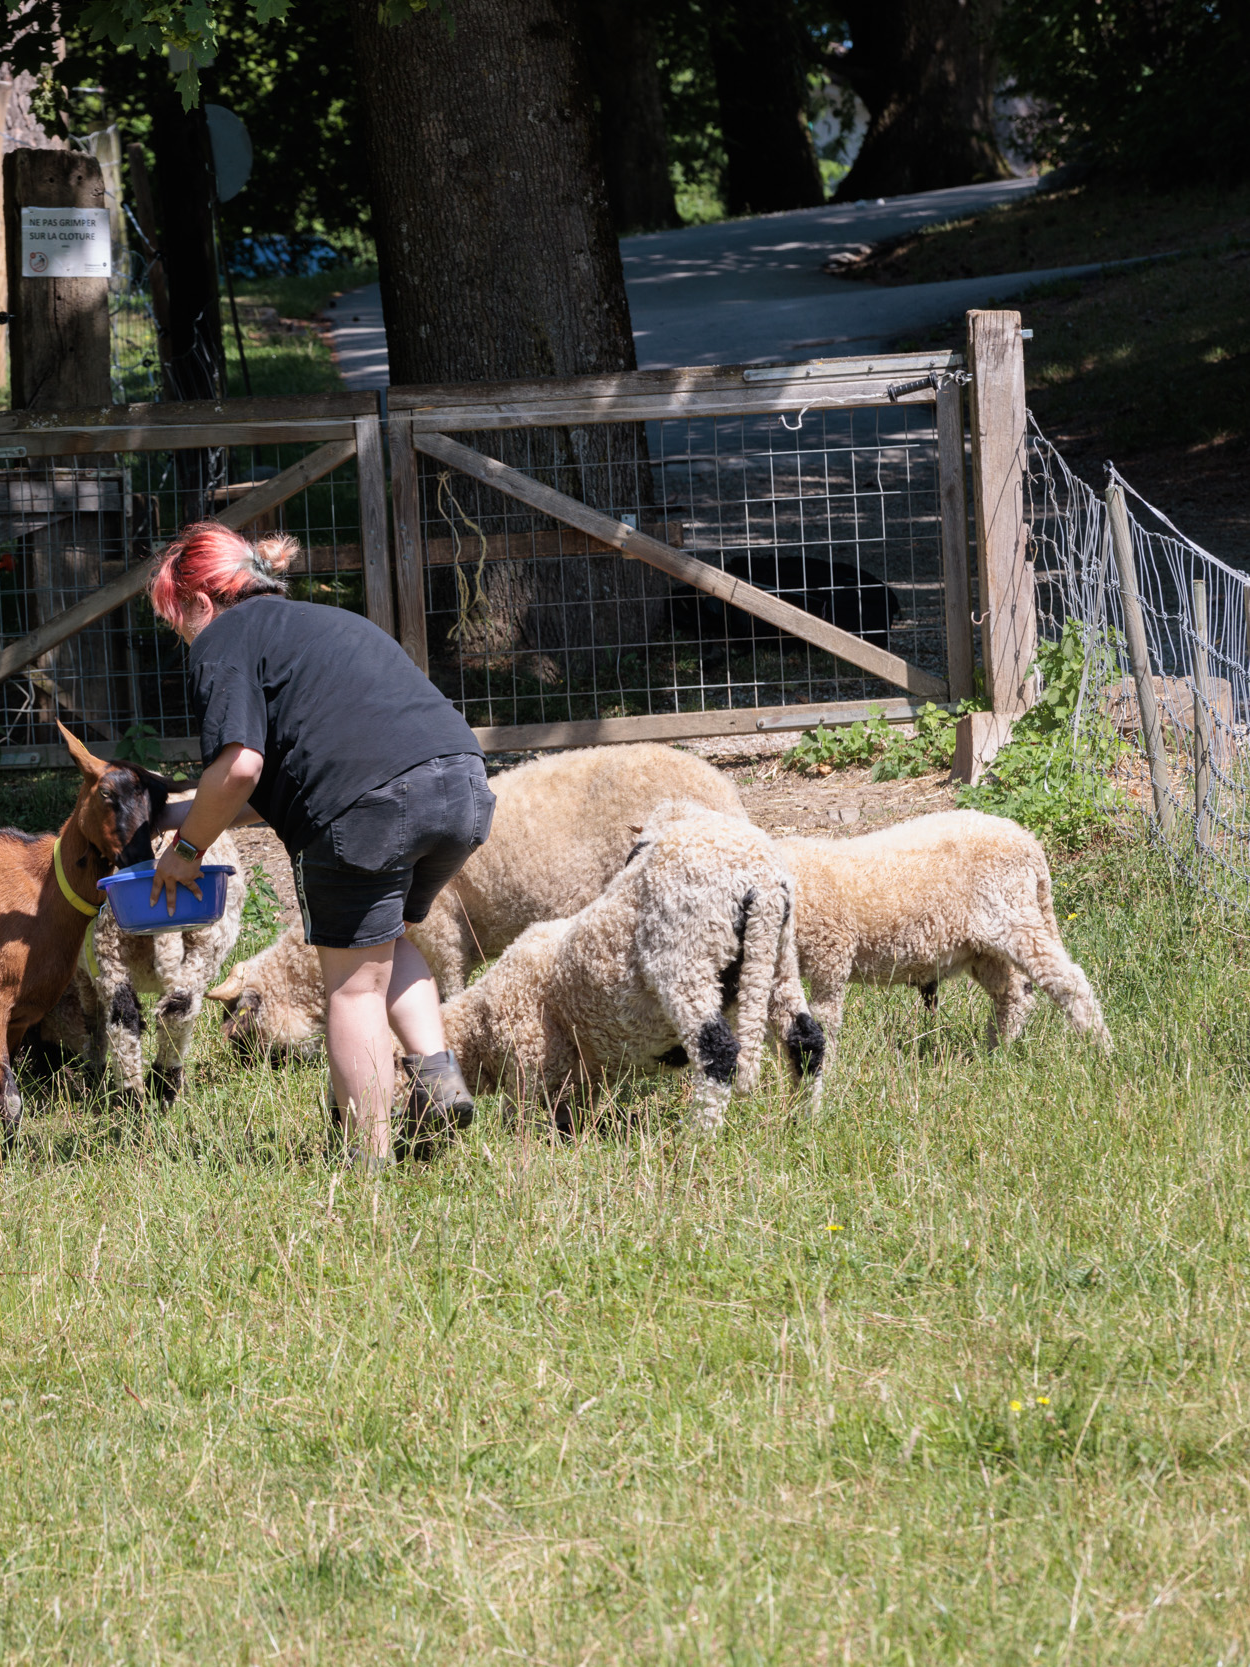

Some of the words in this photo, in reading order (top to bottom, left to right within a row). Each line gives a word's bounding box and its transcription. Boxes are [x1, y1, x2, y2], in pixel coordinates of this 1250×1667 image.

[29, 218, 40, 227] NE
[42, 218, 57, 227] PAS
[59, 218, 96, 227] GRIMPER
[29, 232, 46, 240] SUR
[47, 232, 57, 240] LA
[58, 232, 96, 241] CLOTURE
